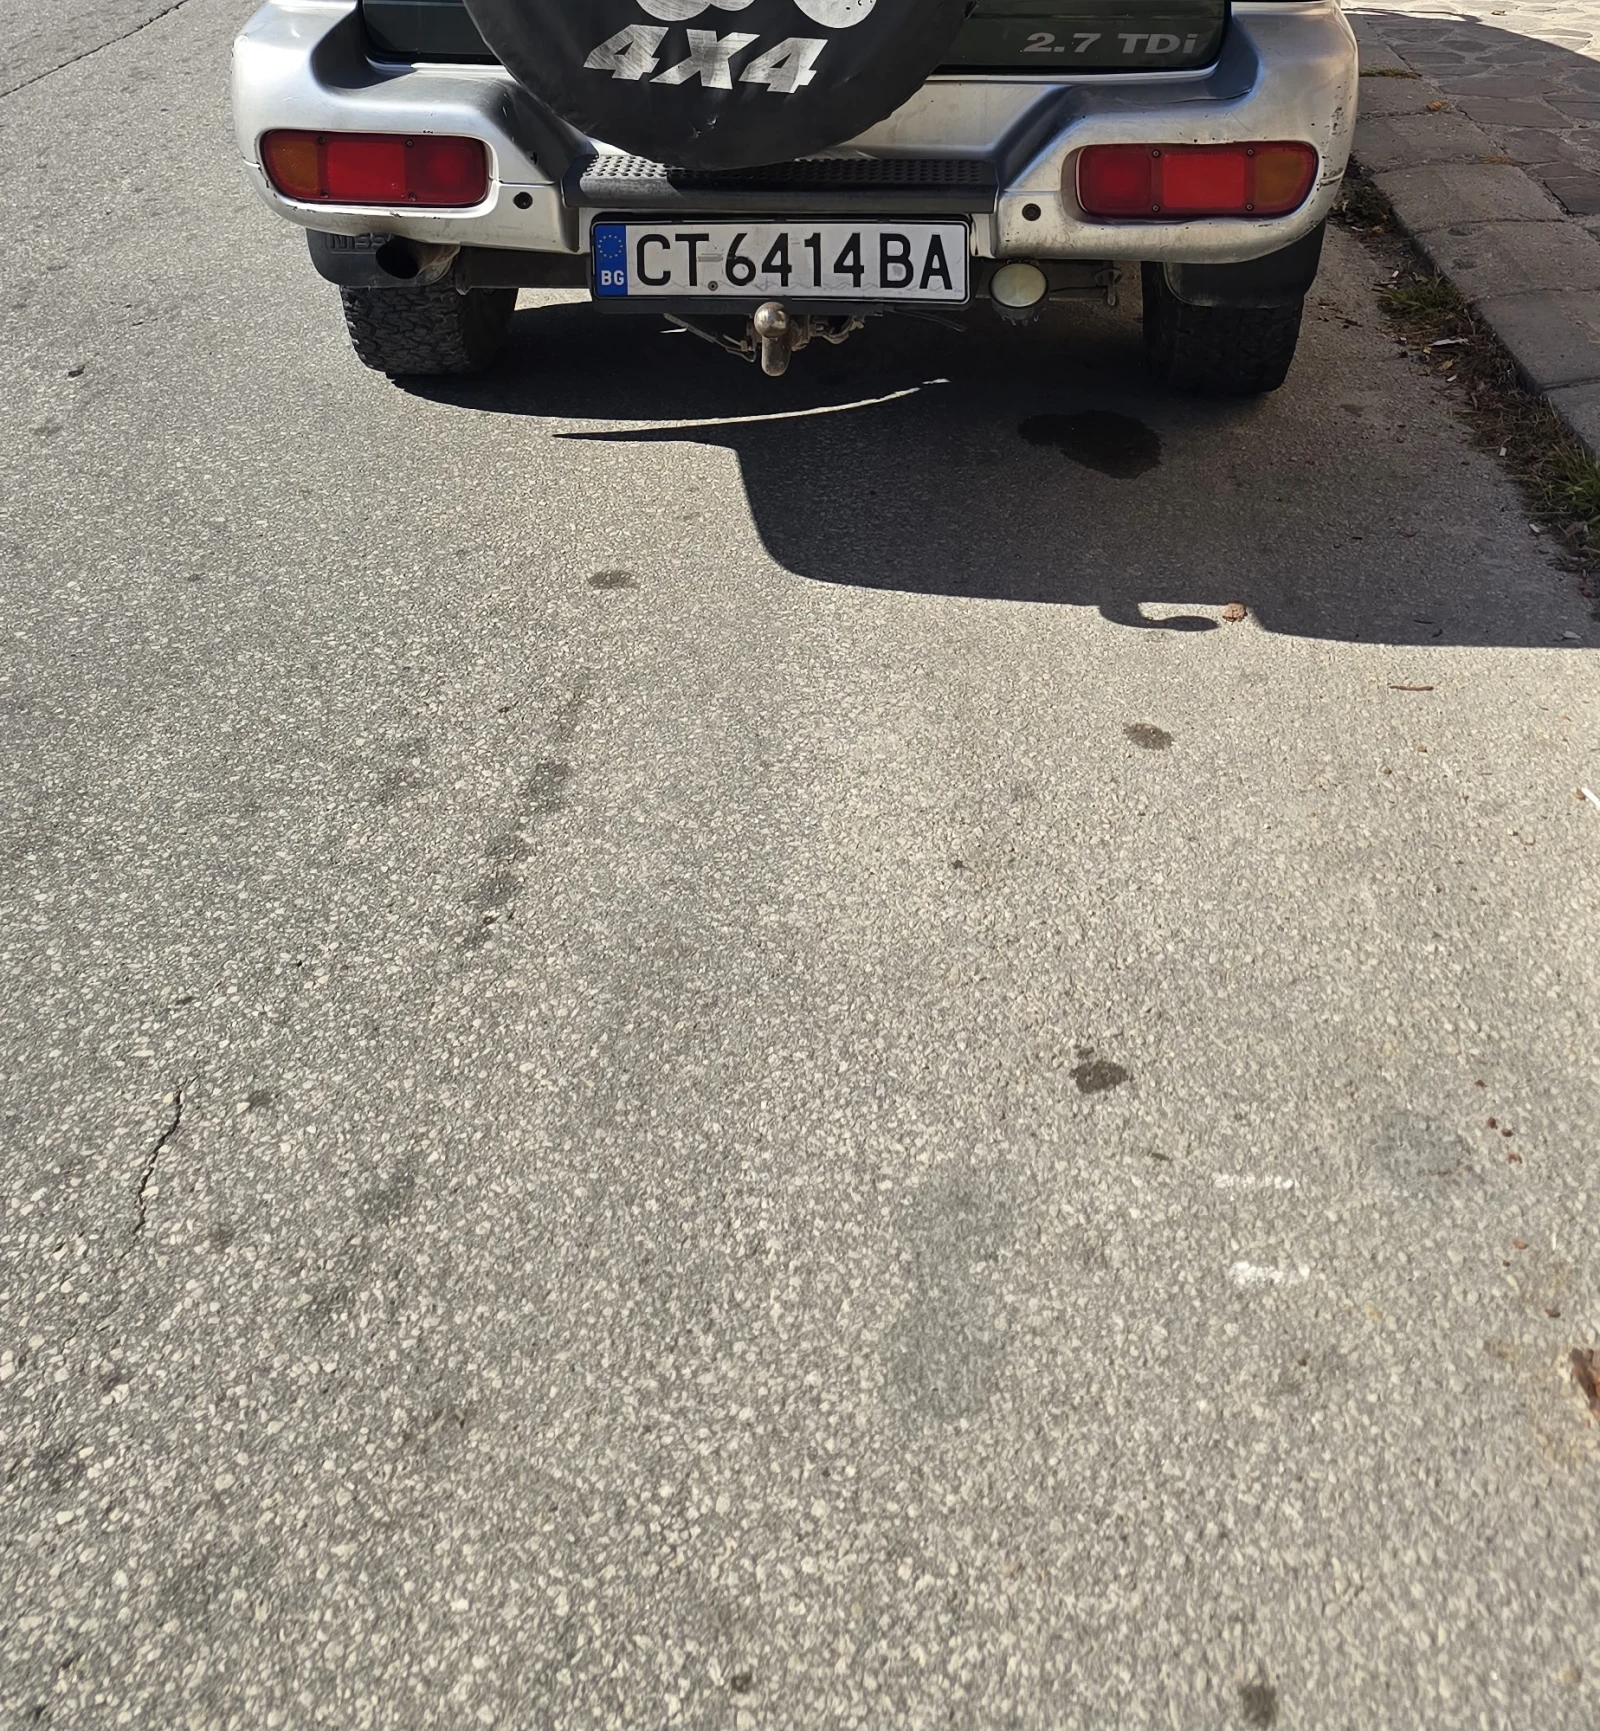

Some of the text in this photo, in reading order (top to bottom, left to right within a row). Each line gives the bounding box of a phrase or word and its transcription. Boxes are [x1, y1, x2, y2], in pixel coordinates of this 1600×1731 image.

[1020, 32, 1198, 54] 2.7 TDi
[583, 24, 828, 94] 4X4
[601, 270, 624, 286] BG
